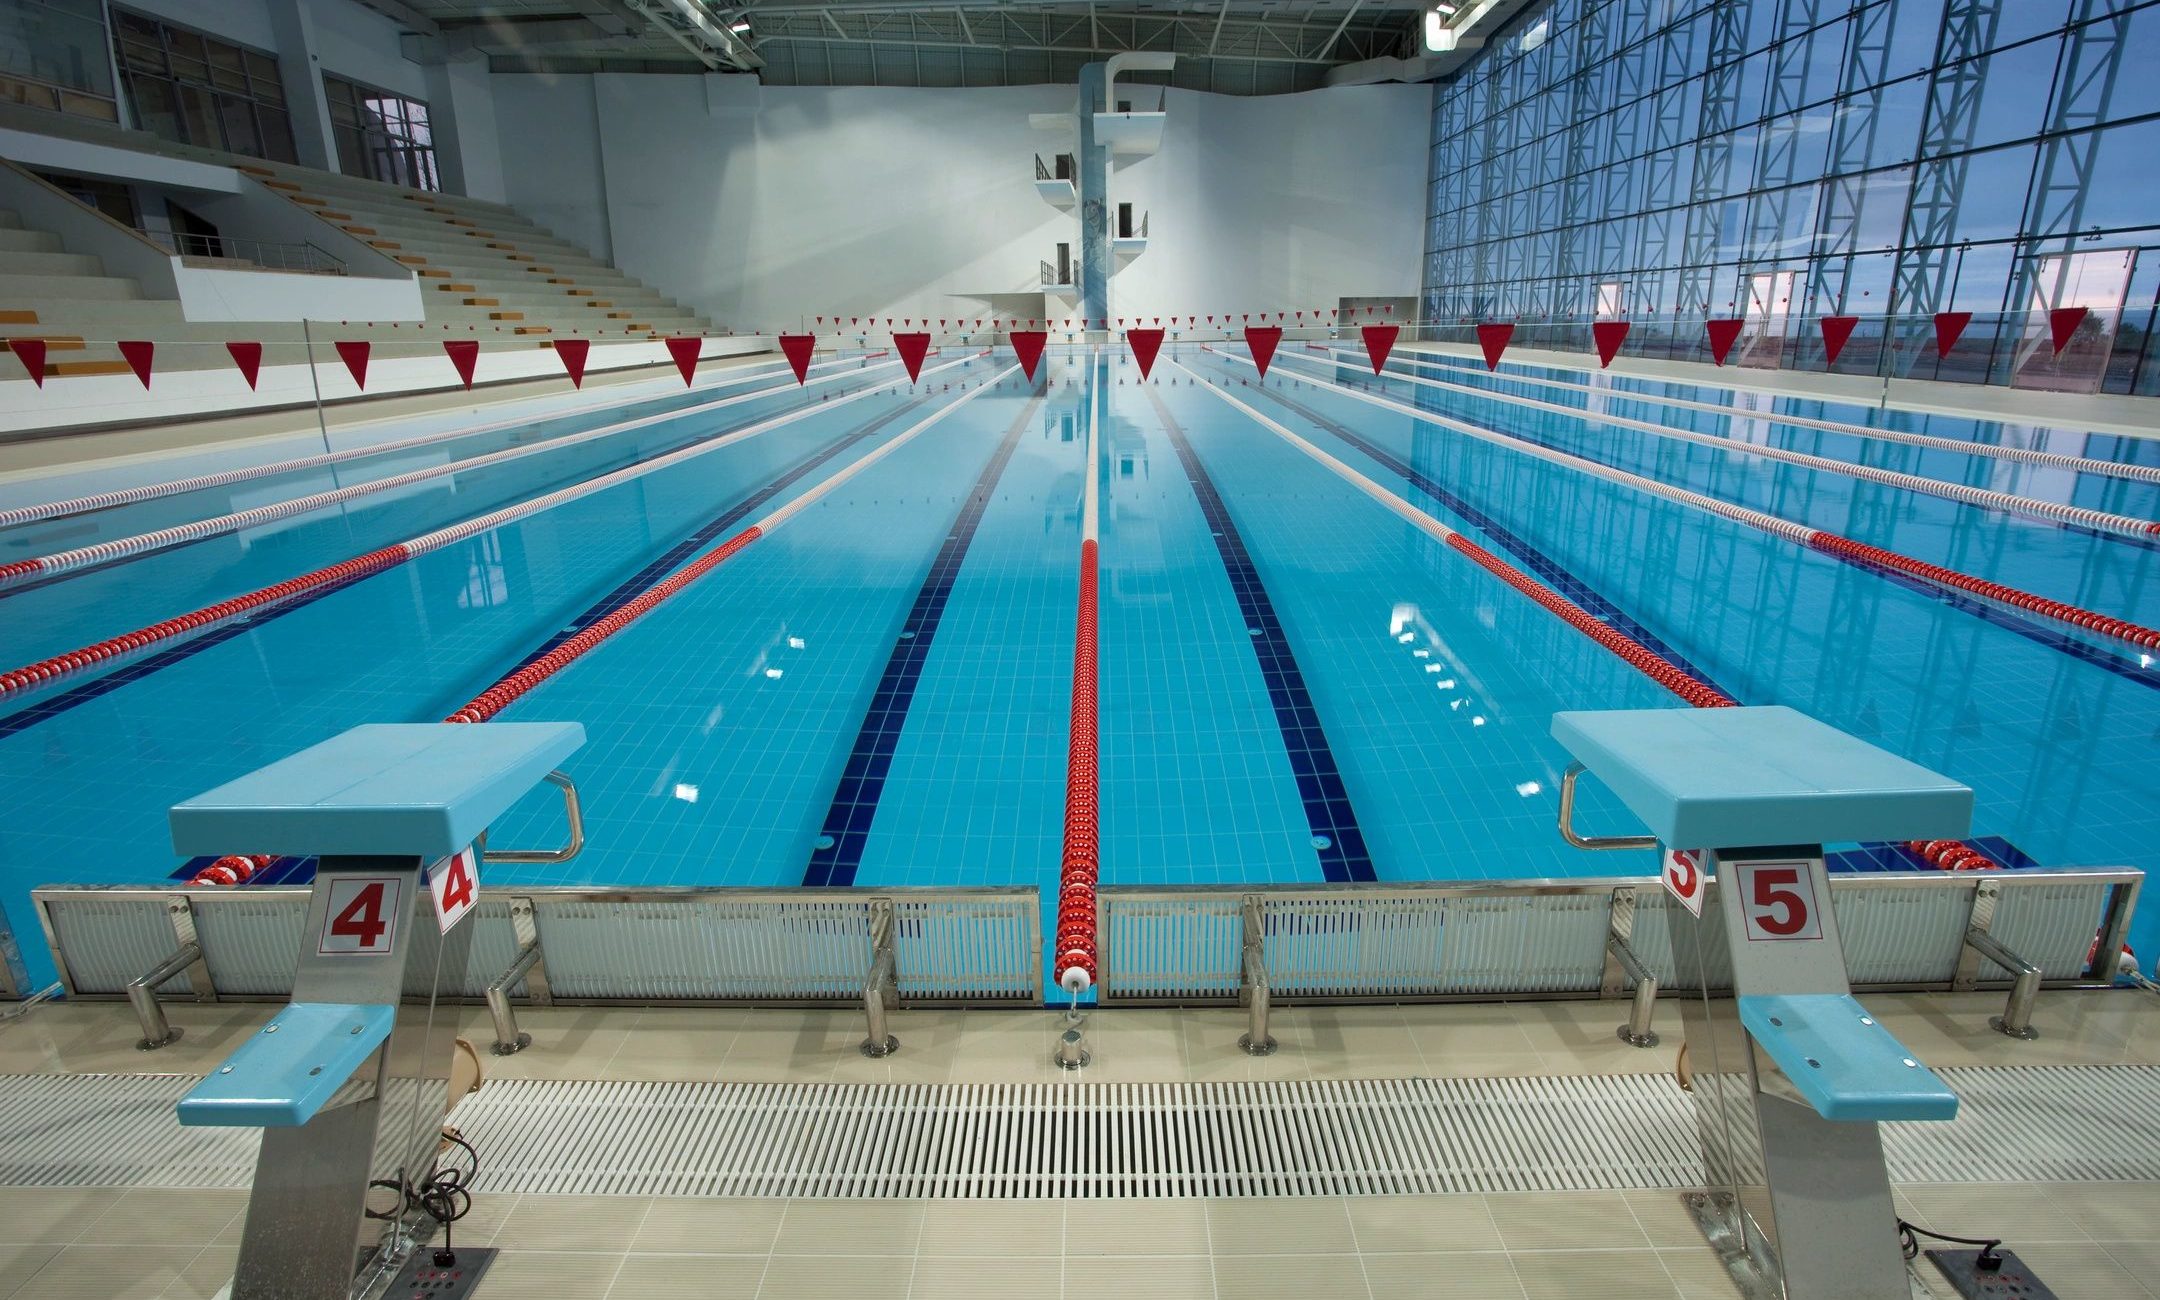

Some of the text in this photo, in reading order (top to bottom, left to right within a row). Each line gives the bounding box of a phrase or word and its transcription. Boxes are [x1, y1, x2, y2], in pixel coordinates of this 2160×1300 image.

[442, 852, 473, 914] 4
[1670, 849, 1700, 898] 5
[1754, 869, 1807, 935] 5
[331, 883, 386, 947] 4
